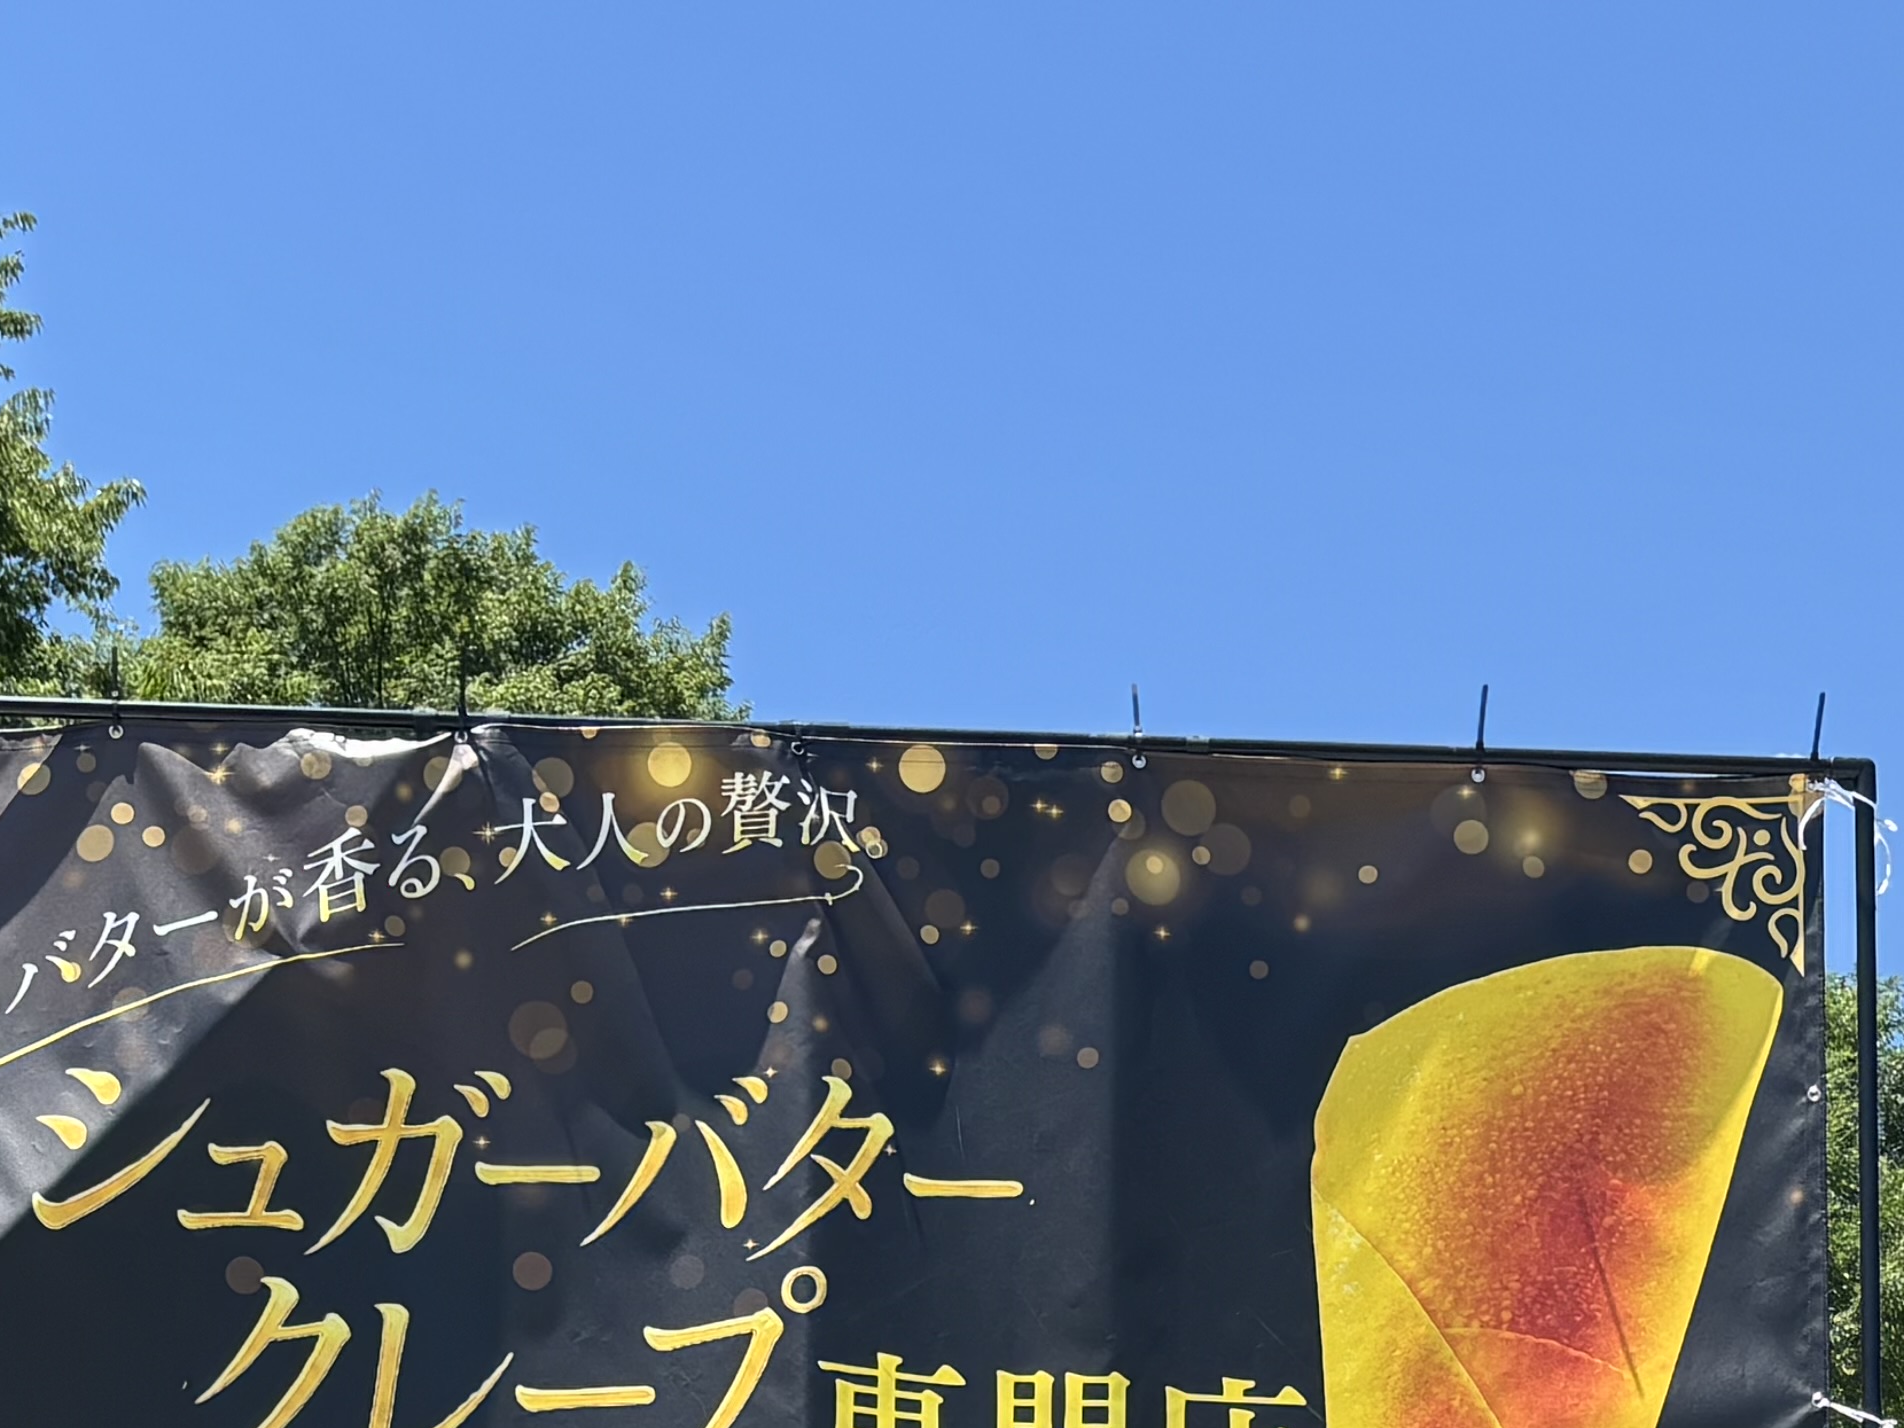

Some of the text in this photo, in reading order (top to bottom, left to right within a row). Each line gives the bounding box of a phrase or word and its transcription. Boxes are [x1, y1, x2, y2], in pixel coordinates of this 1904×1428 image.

[33, 1067, 1023, 1258] シュガーバター
